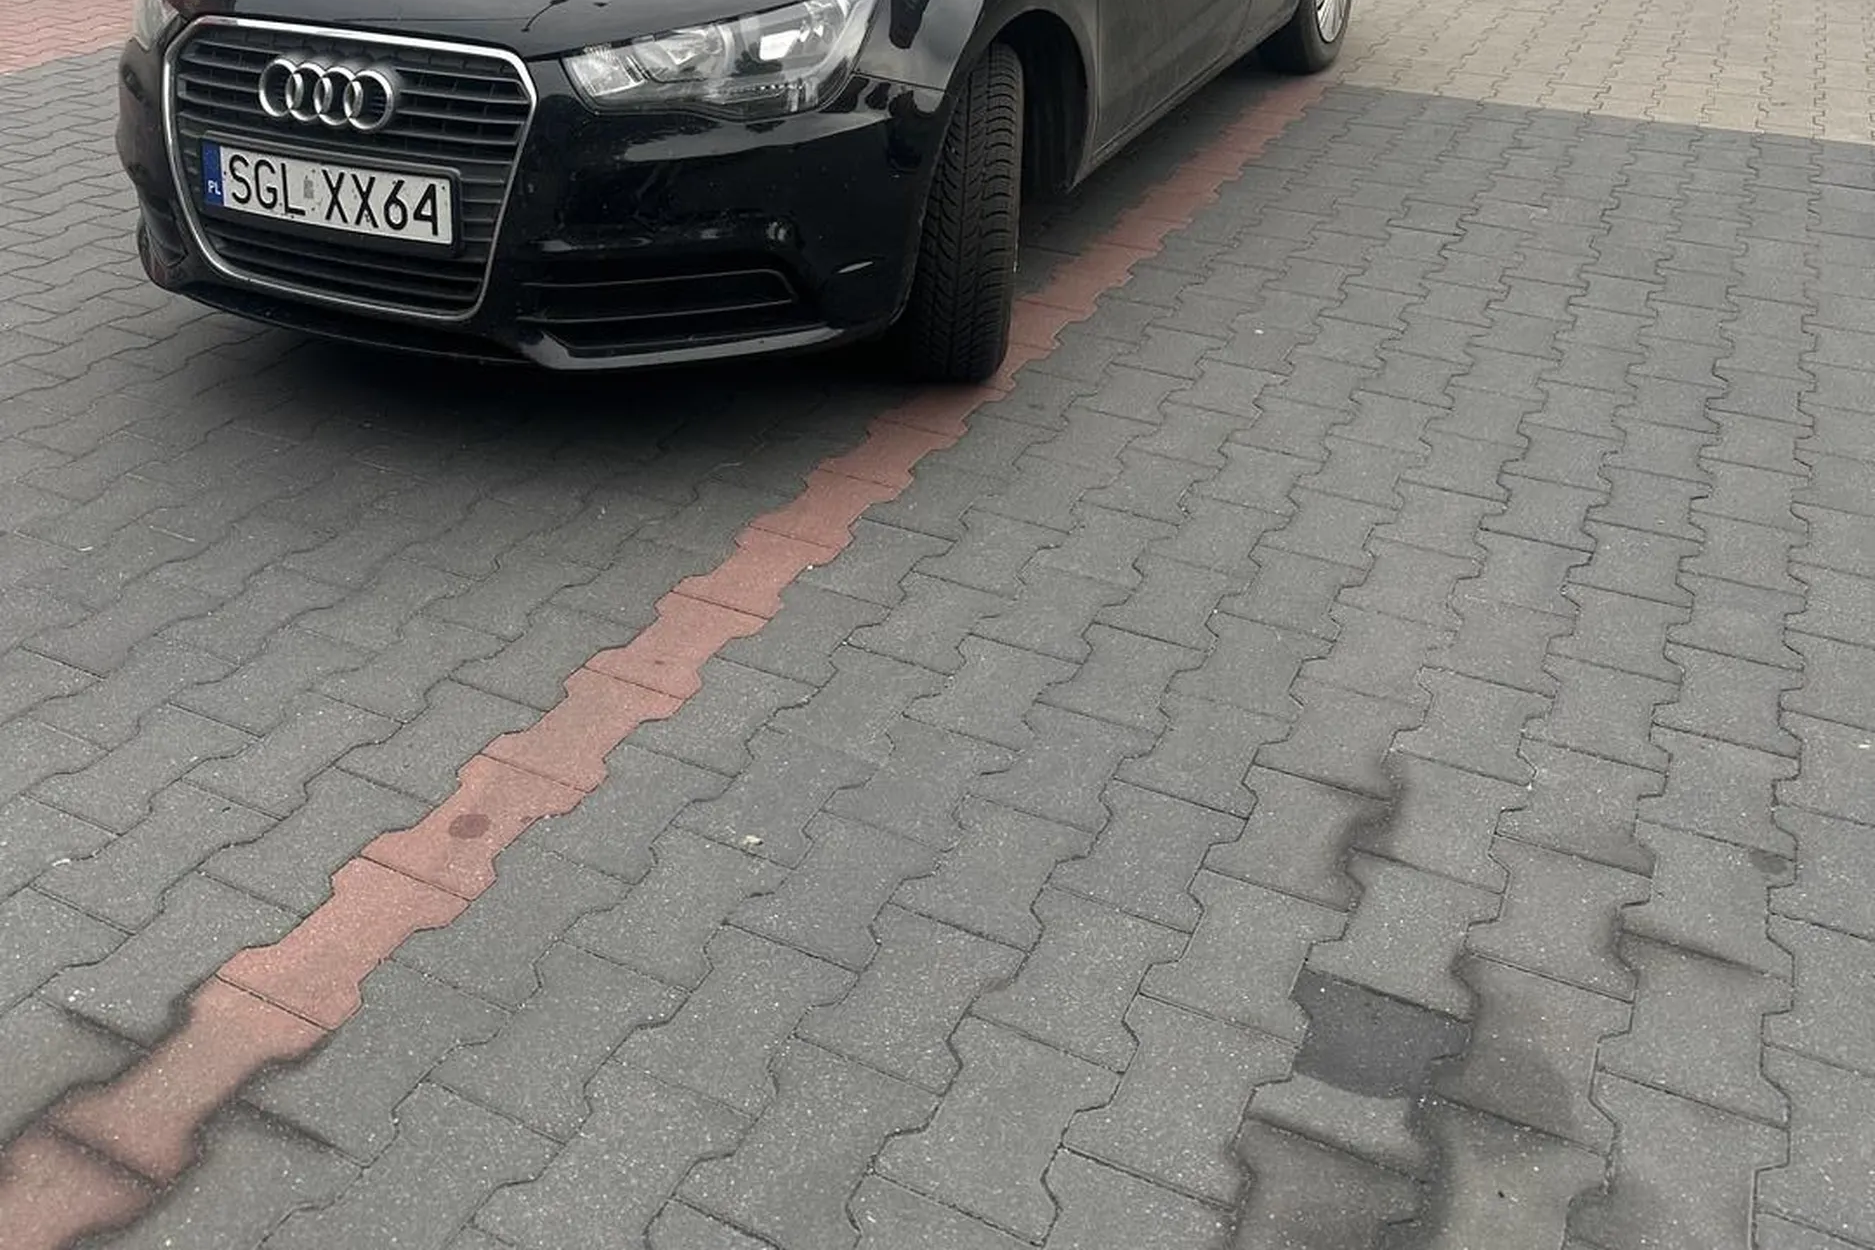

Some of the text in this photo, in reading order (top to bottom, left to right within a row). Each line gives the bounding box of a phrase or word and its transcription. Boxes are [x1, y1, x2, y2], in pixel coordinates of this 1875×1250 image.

[207, 179, 222, 196] PL
[228, 154, 440, 237] SGL XX64
